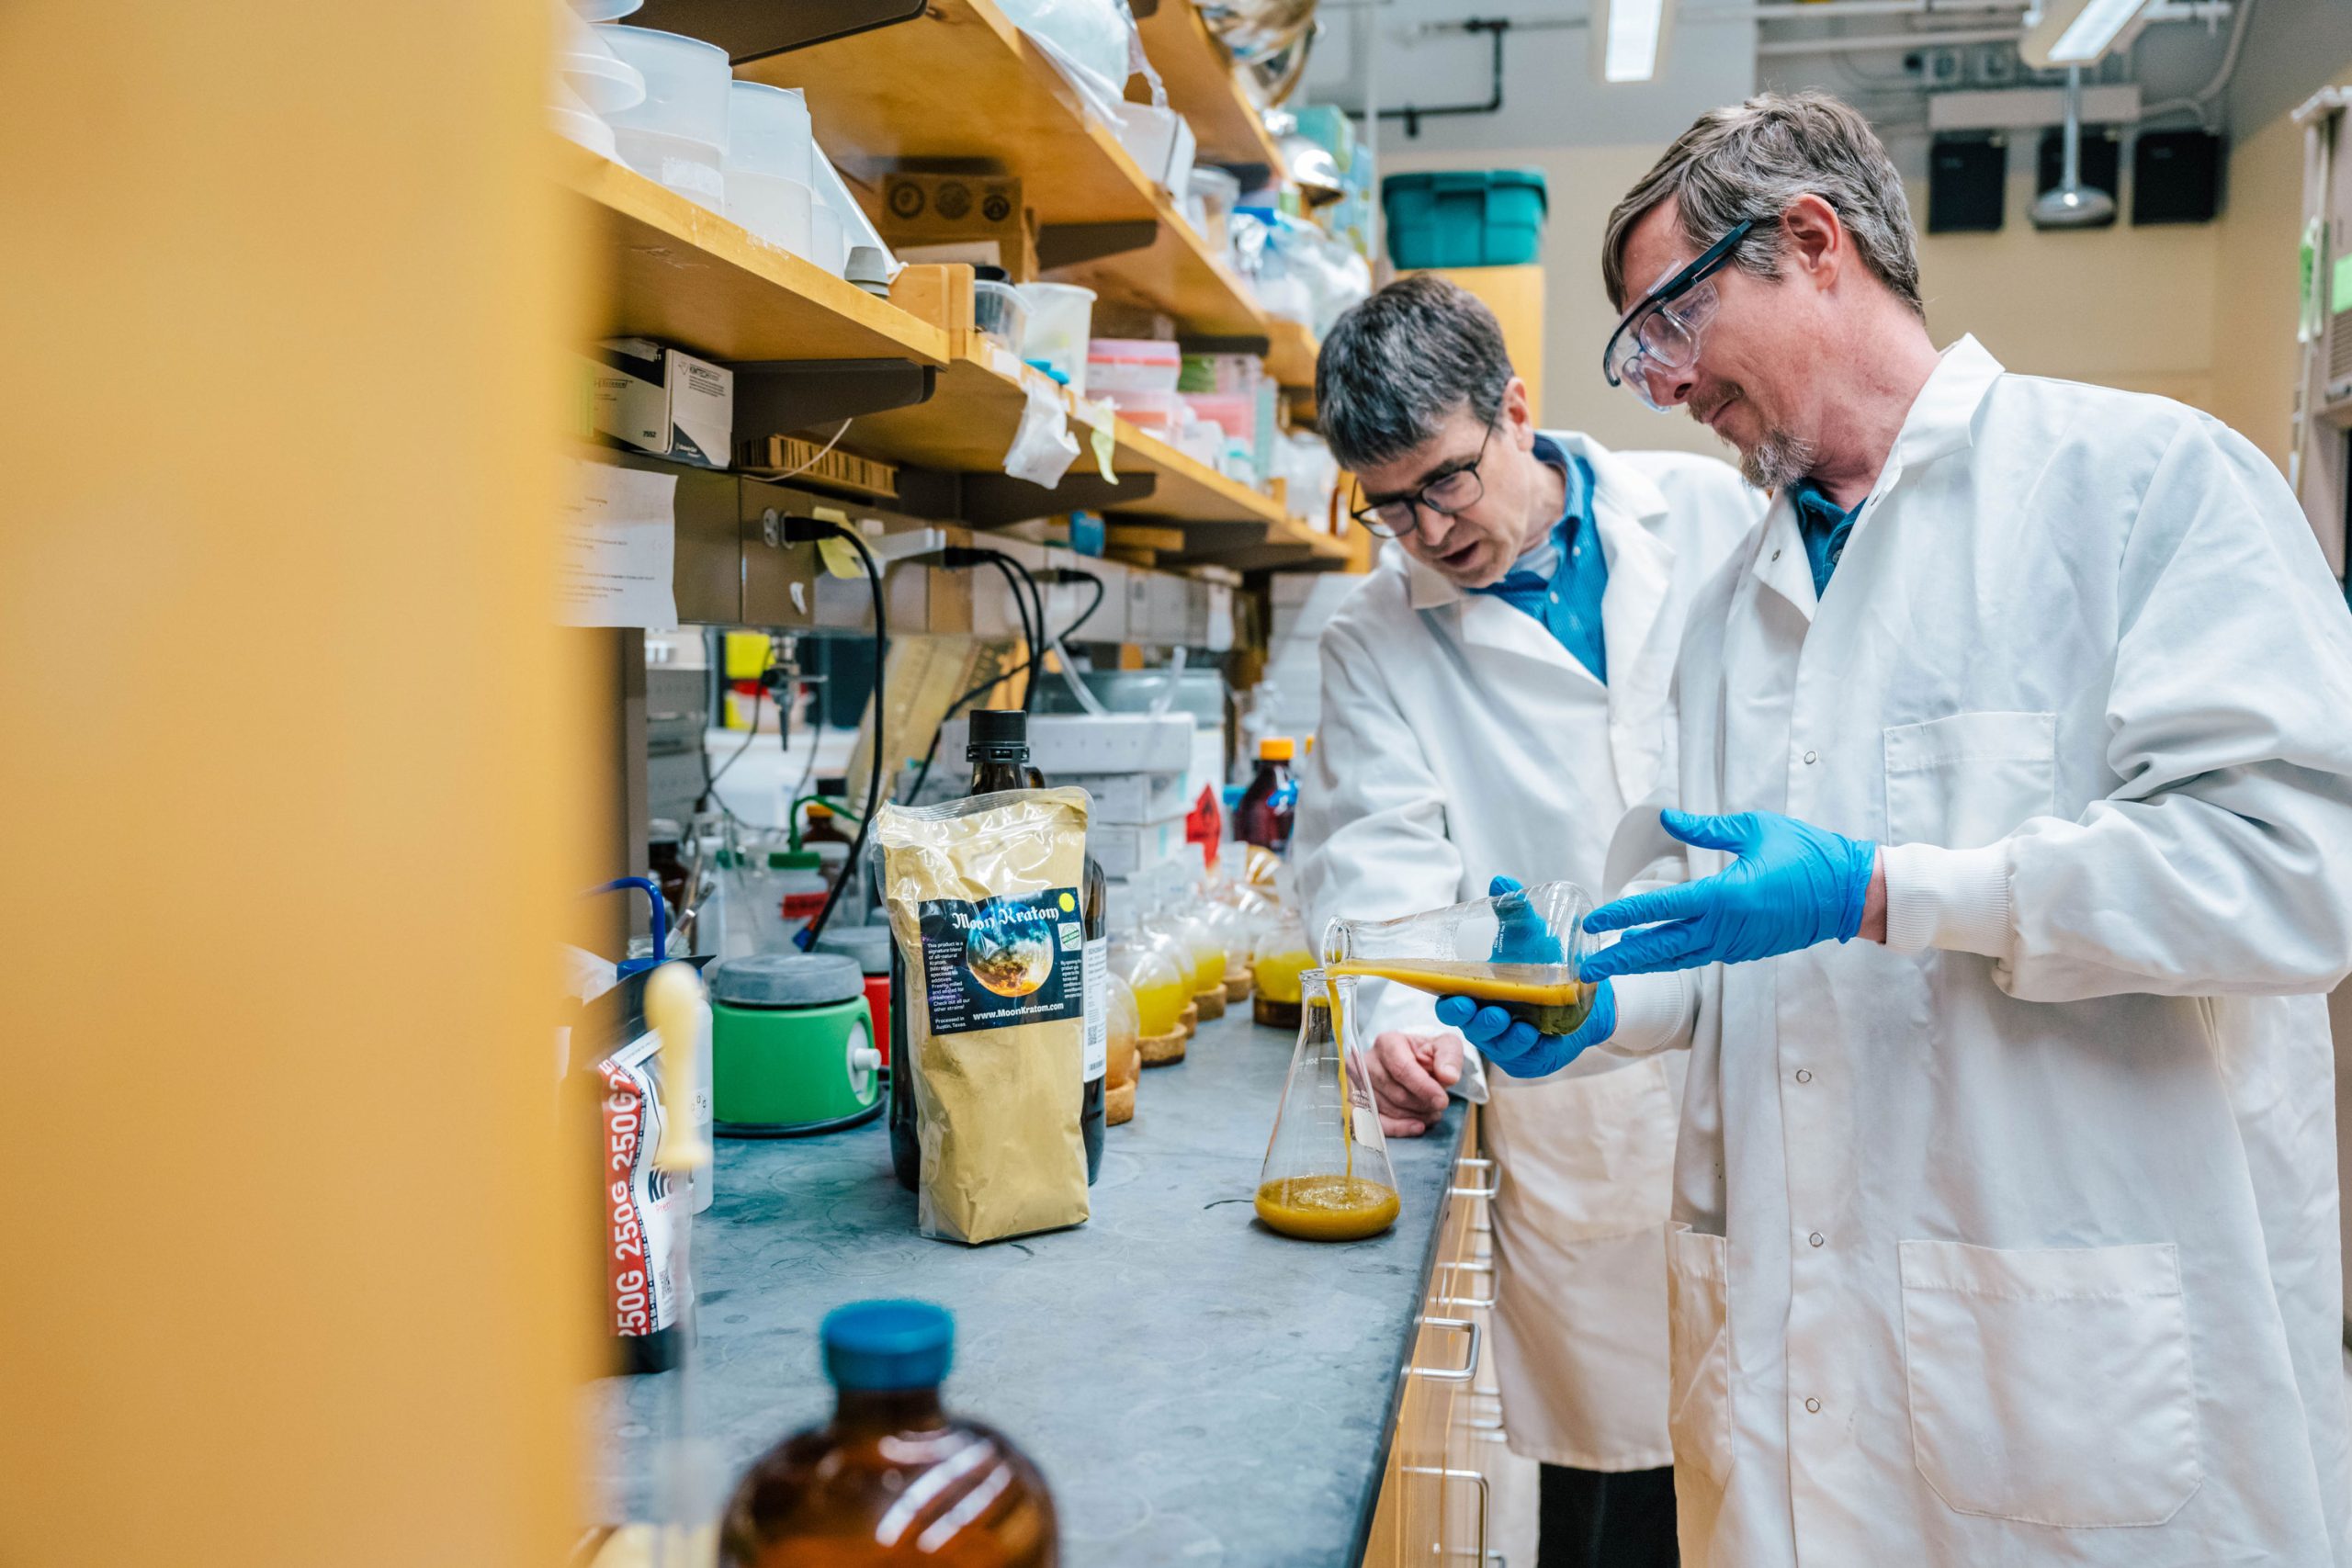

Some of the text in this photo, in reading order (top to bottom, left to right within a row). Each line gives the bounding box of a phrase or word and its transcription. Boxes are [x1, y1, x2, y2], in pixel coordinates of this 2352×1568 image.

[951, 905, 1059, 930] Moon Kratom
[972, 1002, 1064, 1021] www.MoonKratom.com
[608, 1092, 639, 1172] 250G
[612, 1180, 642, 1261] 250G
